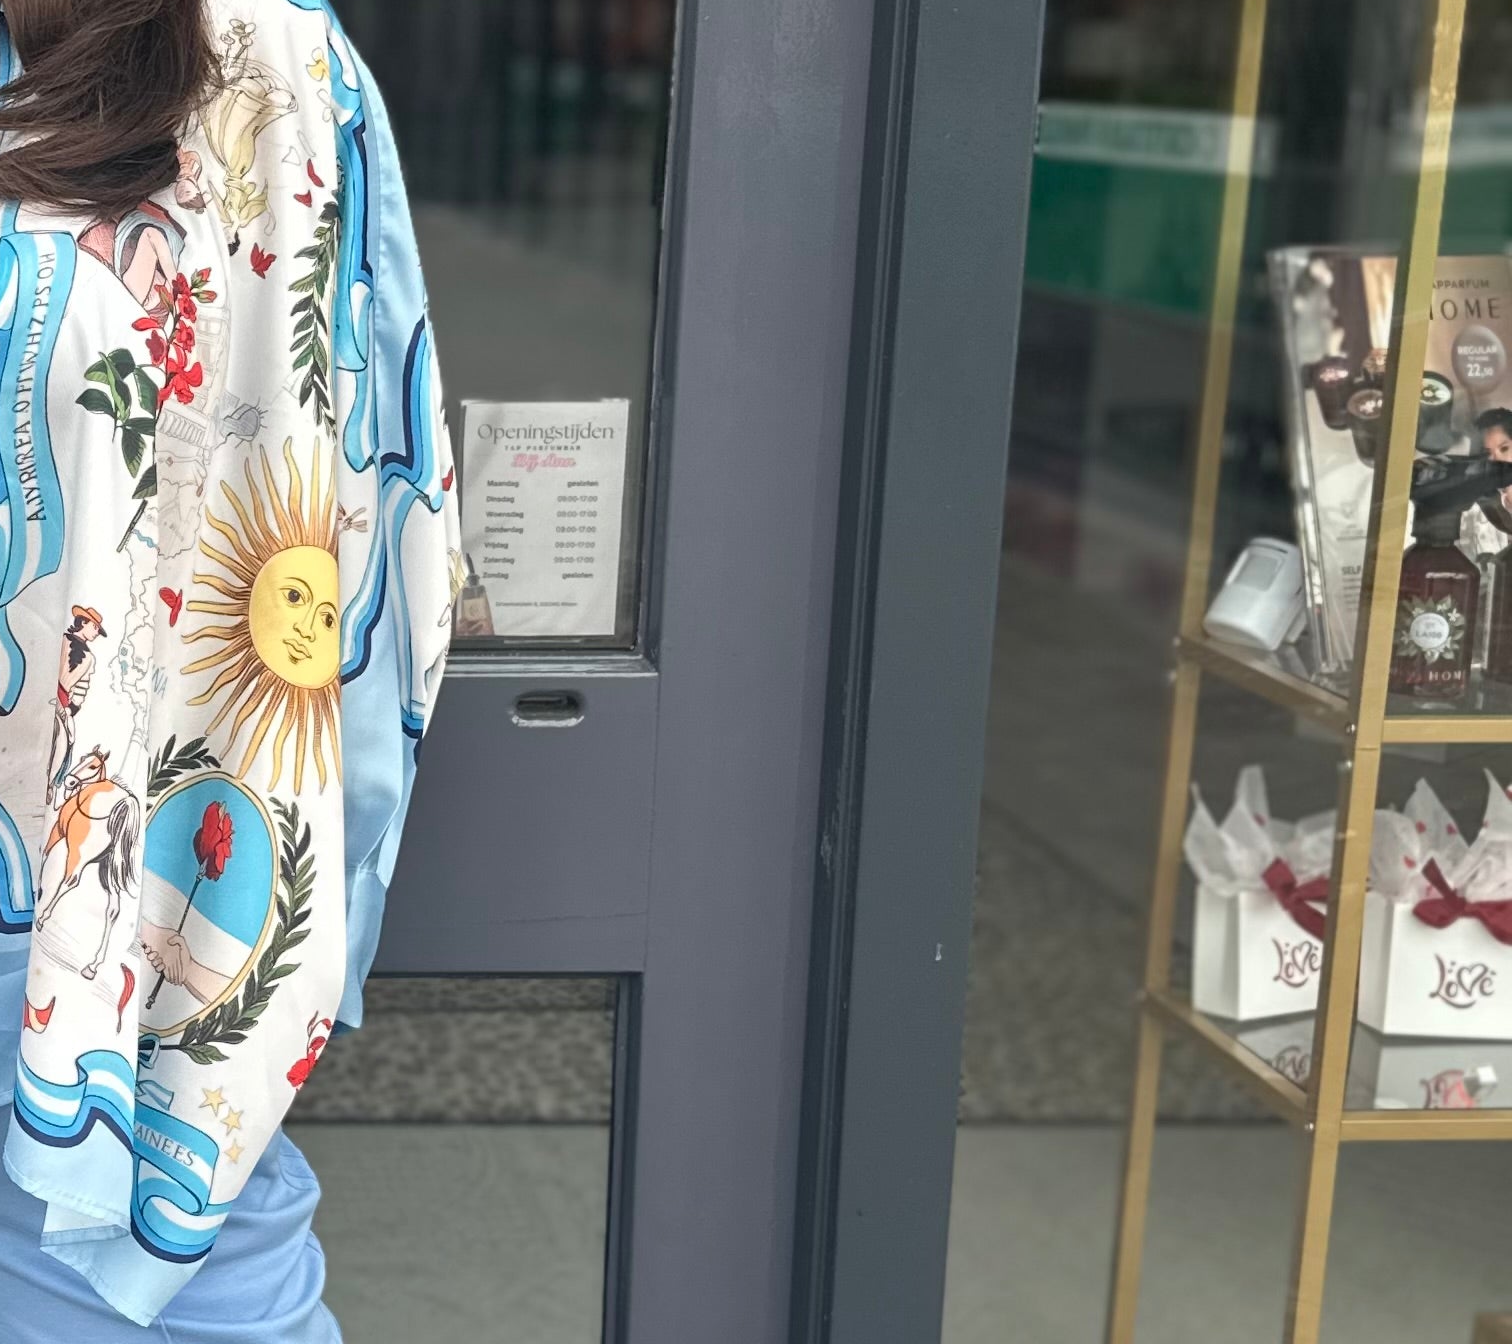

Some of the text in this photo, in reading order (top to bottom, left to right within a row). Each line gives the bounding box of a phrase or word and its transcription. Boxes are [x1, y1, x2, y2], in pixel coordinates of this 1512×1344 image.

[1429, 297, 1501, 321] OME
[1457, 346, 1497, 355] REGULAR
[477, 422, 615, 445] Openingstijden
[487, 480, 520, 489] Maandag
[486, 495, 515, 504] Dinsdag
[485, 511, 524, 519] Woensdag
[484, 526, 524, 534] Donderdag
